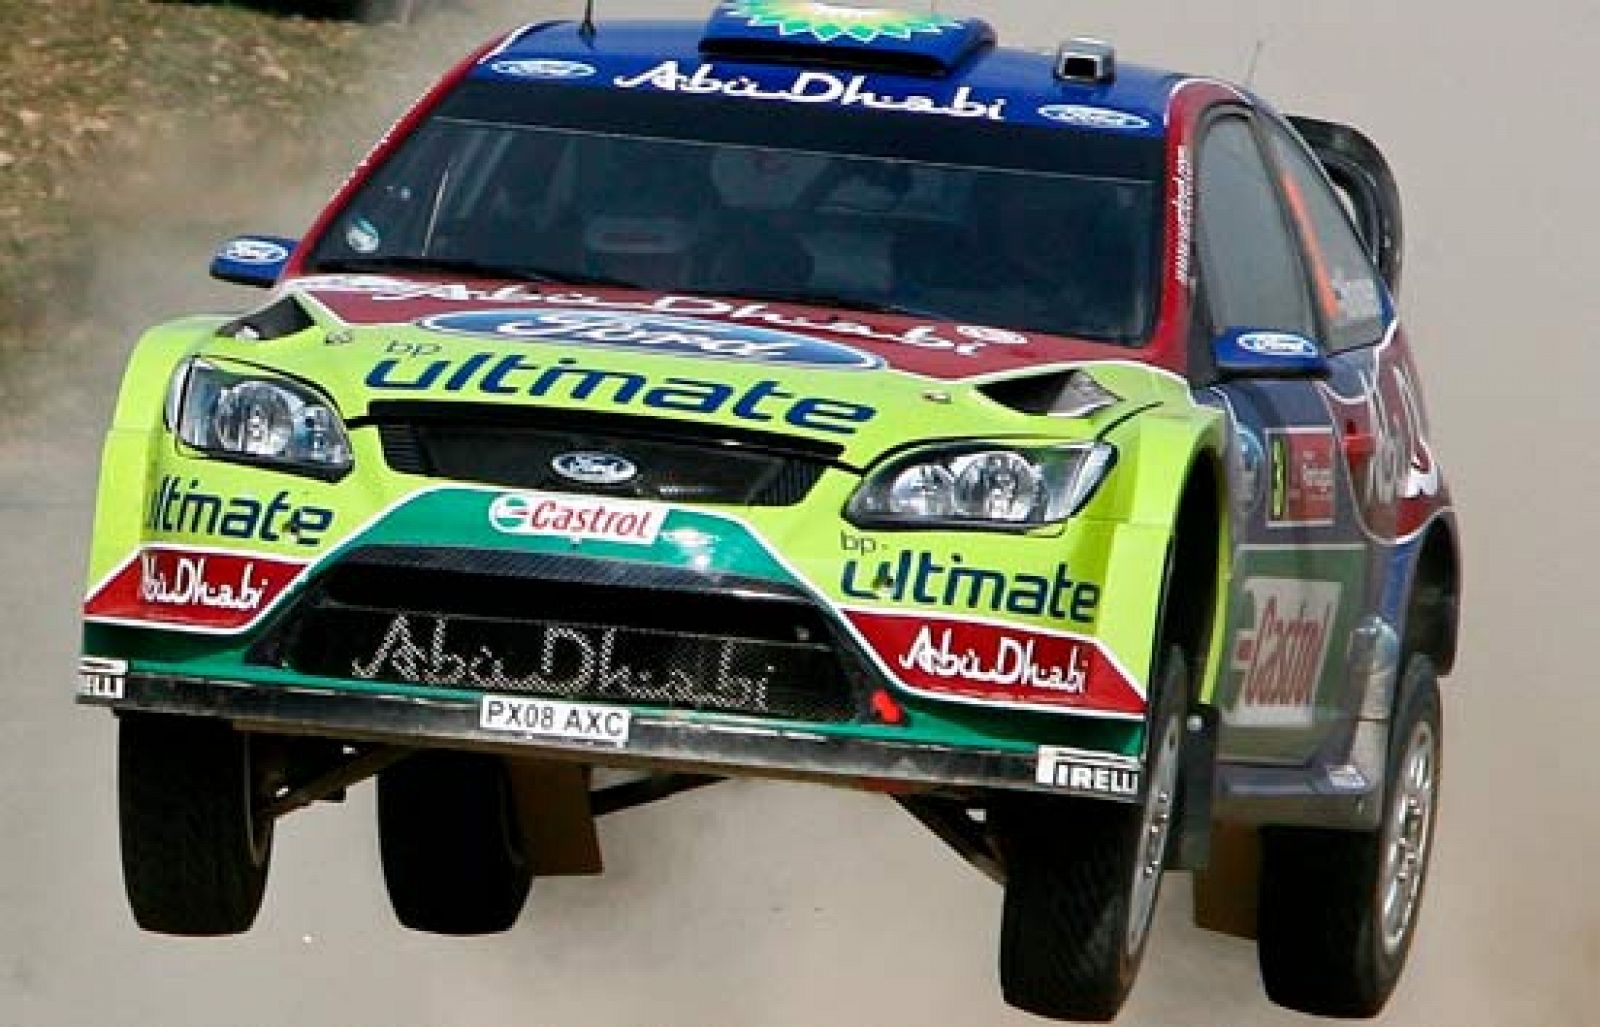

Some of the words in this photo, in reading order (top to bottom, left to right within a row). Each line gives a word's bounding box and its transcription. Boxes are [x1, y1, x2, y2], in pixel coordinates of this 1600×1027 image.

[613, 60, 792, 102] Abu
[793, 72, 1006, 121] Dhabi
[497, 313, 786, 358] Ford
[650, 296, 988, 357] Dhabi
[365, 352, 877, 434] ultimate
[532, 500, 652, 537] Castrol
[840, 531, 877, 554] bp
[176, 558, 270, 609] Dhabi
[841, 549, 1100, 622] ultimate
[352, 614, 540, 690] Abu
[541, 624, 778, 712] Dhabi
[899, 625, 985, 677] Abu
[986, 636, 1088, 693] Dhabi
[486, 700, 554, 731] PX08
[564, 707, 624, 736] AXC
